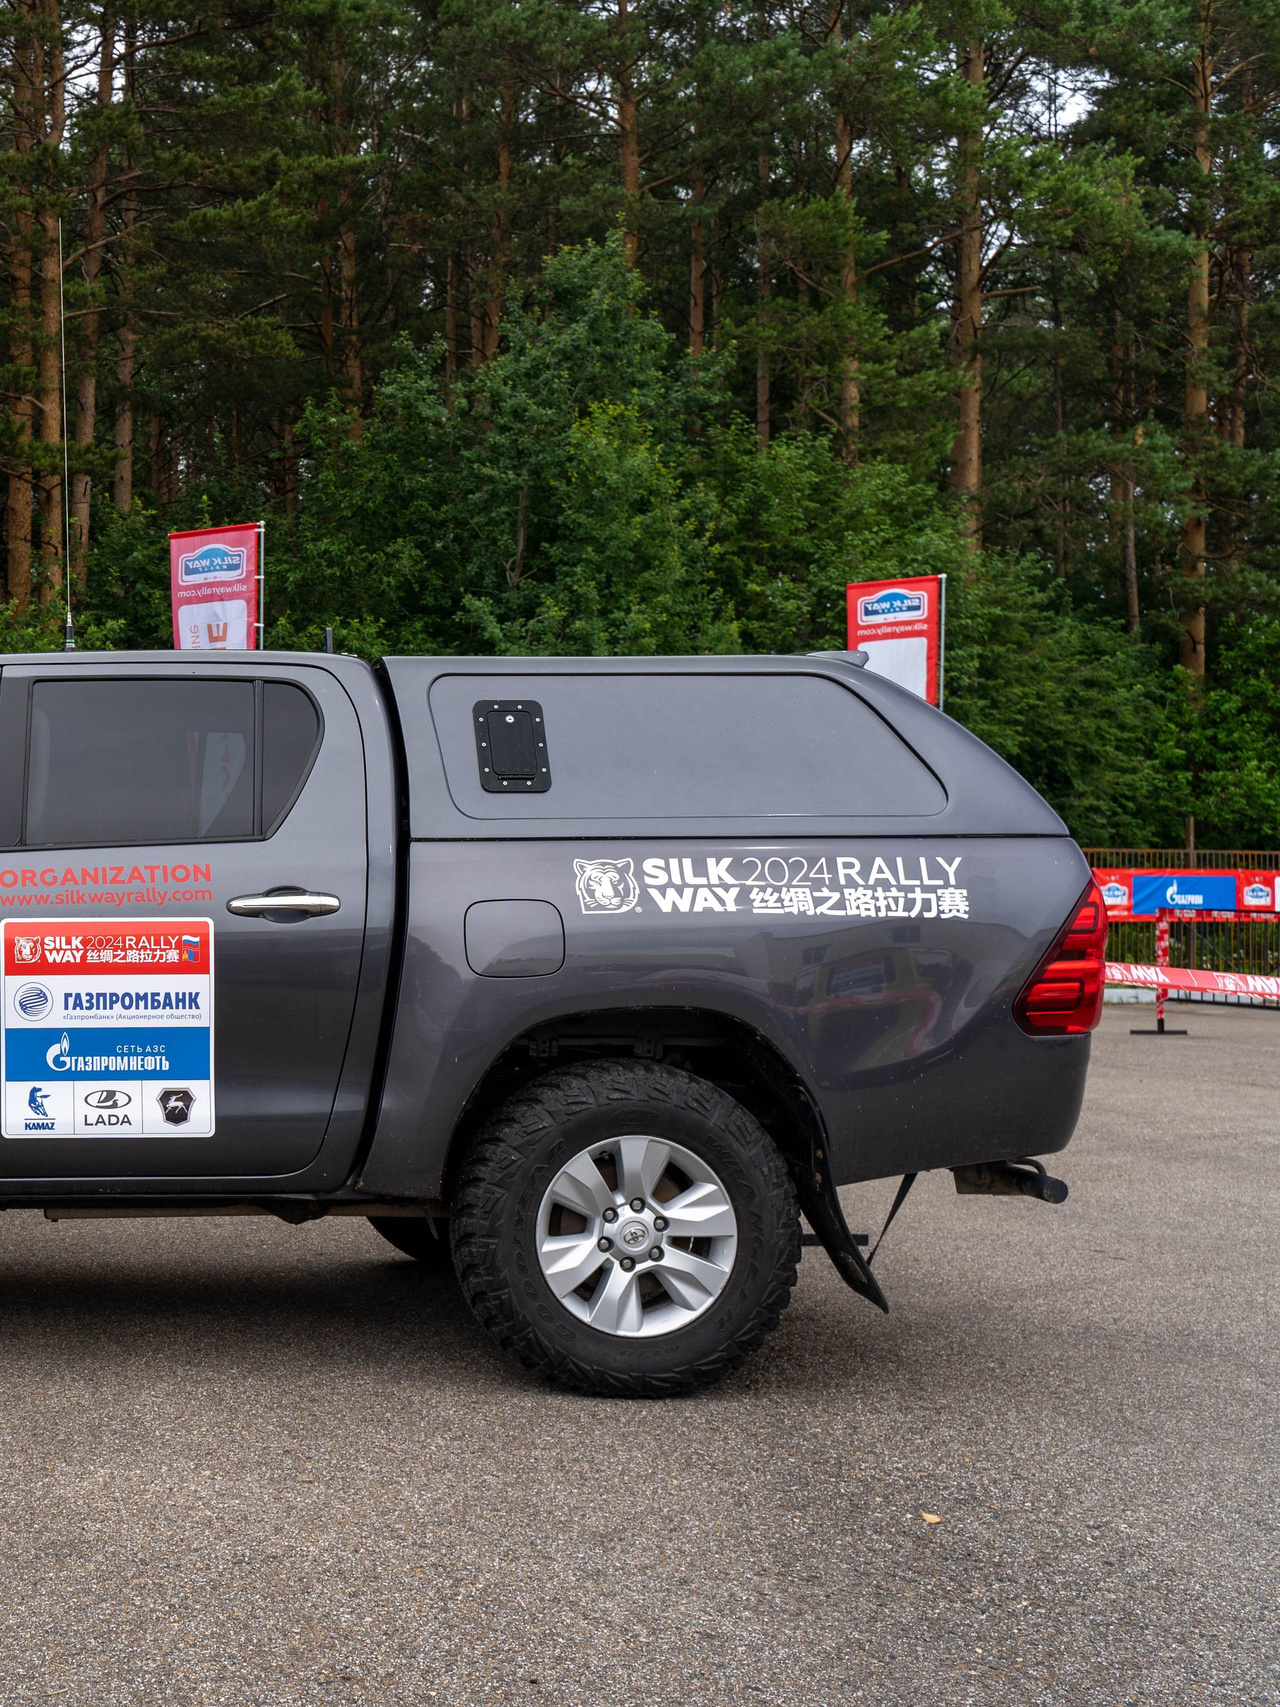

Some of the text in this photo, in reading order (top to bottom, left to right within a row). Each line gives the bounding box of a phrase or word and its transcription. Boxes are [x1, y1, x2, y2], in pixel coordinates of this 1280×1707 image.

[642, 856, 963, 886] SILK 2024 RALLY
[0, 887, 213, 908] www.silkwayrally.com
[646, 887, 970, 919] WAY 丝绸之路拉力赛
[43, 935, 179, 950] SILK 2024 RALLY
[44, 949, 179, 963] WAY 丝绸之路拉力赛
[63, 991, 200, 1011] ГАЗПРОМБАНК
[62, 1013, 202, 1021] «Газпромбанк» (Акционерное общество)
[116, 1045, 166, 1053] СЕТЬ АЗС
[71, 1056, 170, 1071] ГАЗПРОМНЕФТЬ
[24, 1122, 55, 1131] KAMAZ
[84, 1114, 132, 1126] LADA
